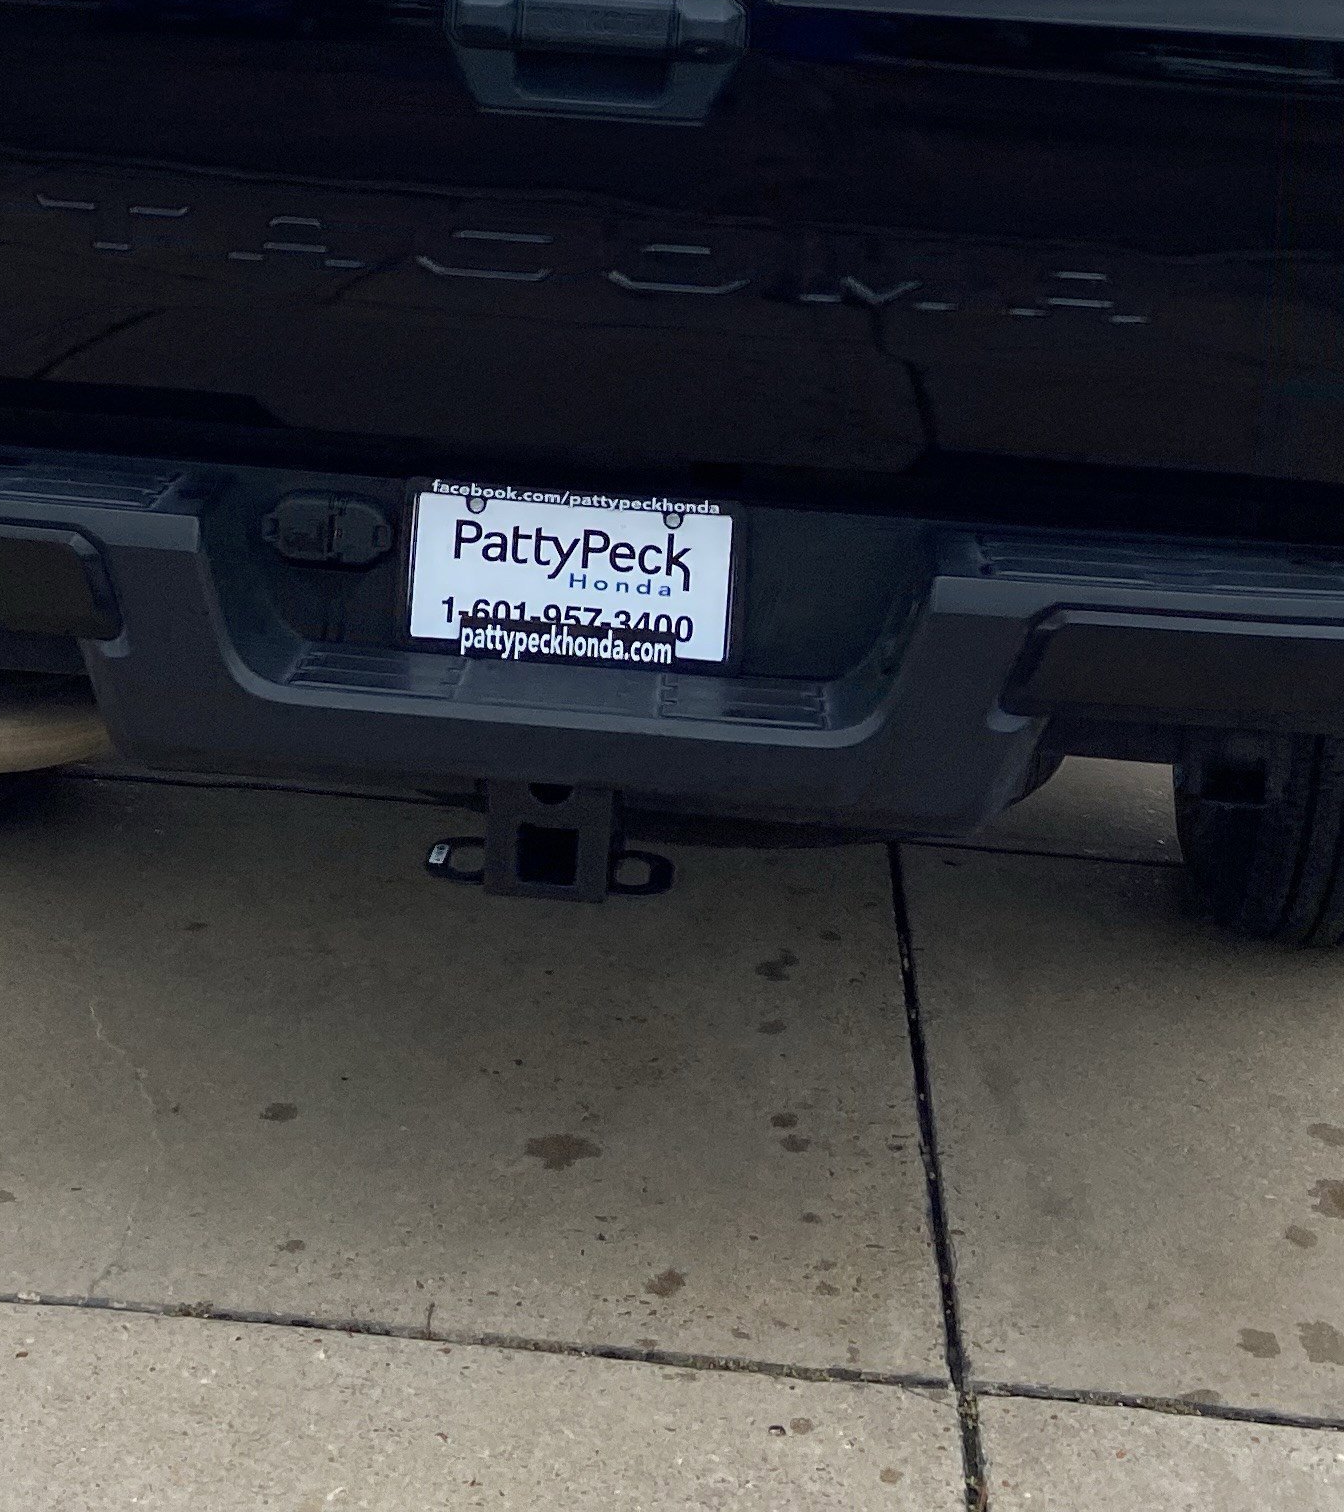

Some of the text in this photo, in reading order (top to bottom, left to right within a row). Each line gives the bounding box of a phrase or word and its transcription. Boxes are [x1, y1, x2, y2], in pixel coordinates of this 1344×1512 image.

[35, 180, 1152, 324] TACOMA
[431, 478, 721, 515] facebook.com/pattypeckhonda
[453, 519, 693, 592] PattyPeck
[569, 572, 672, 597] Honda
[459, 621, 673, 664] pattypeckhonda.com
